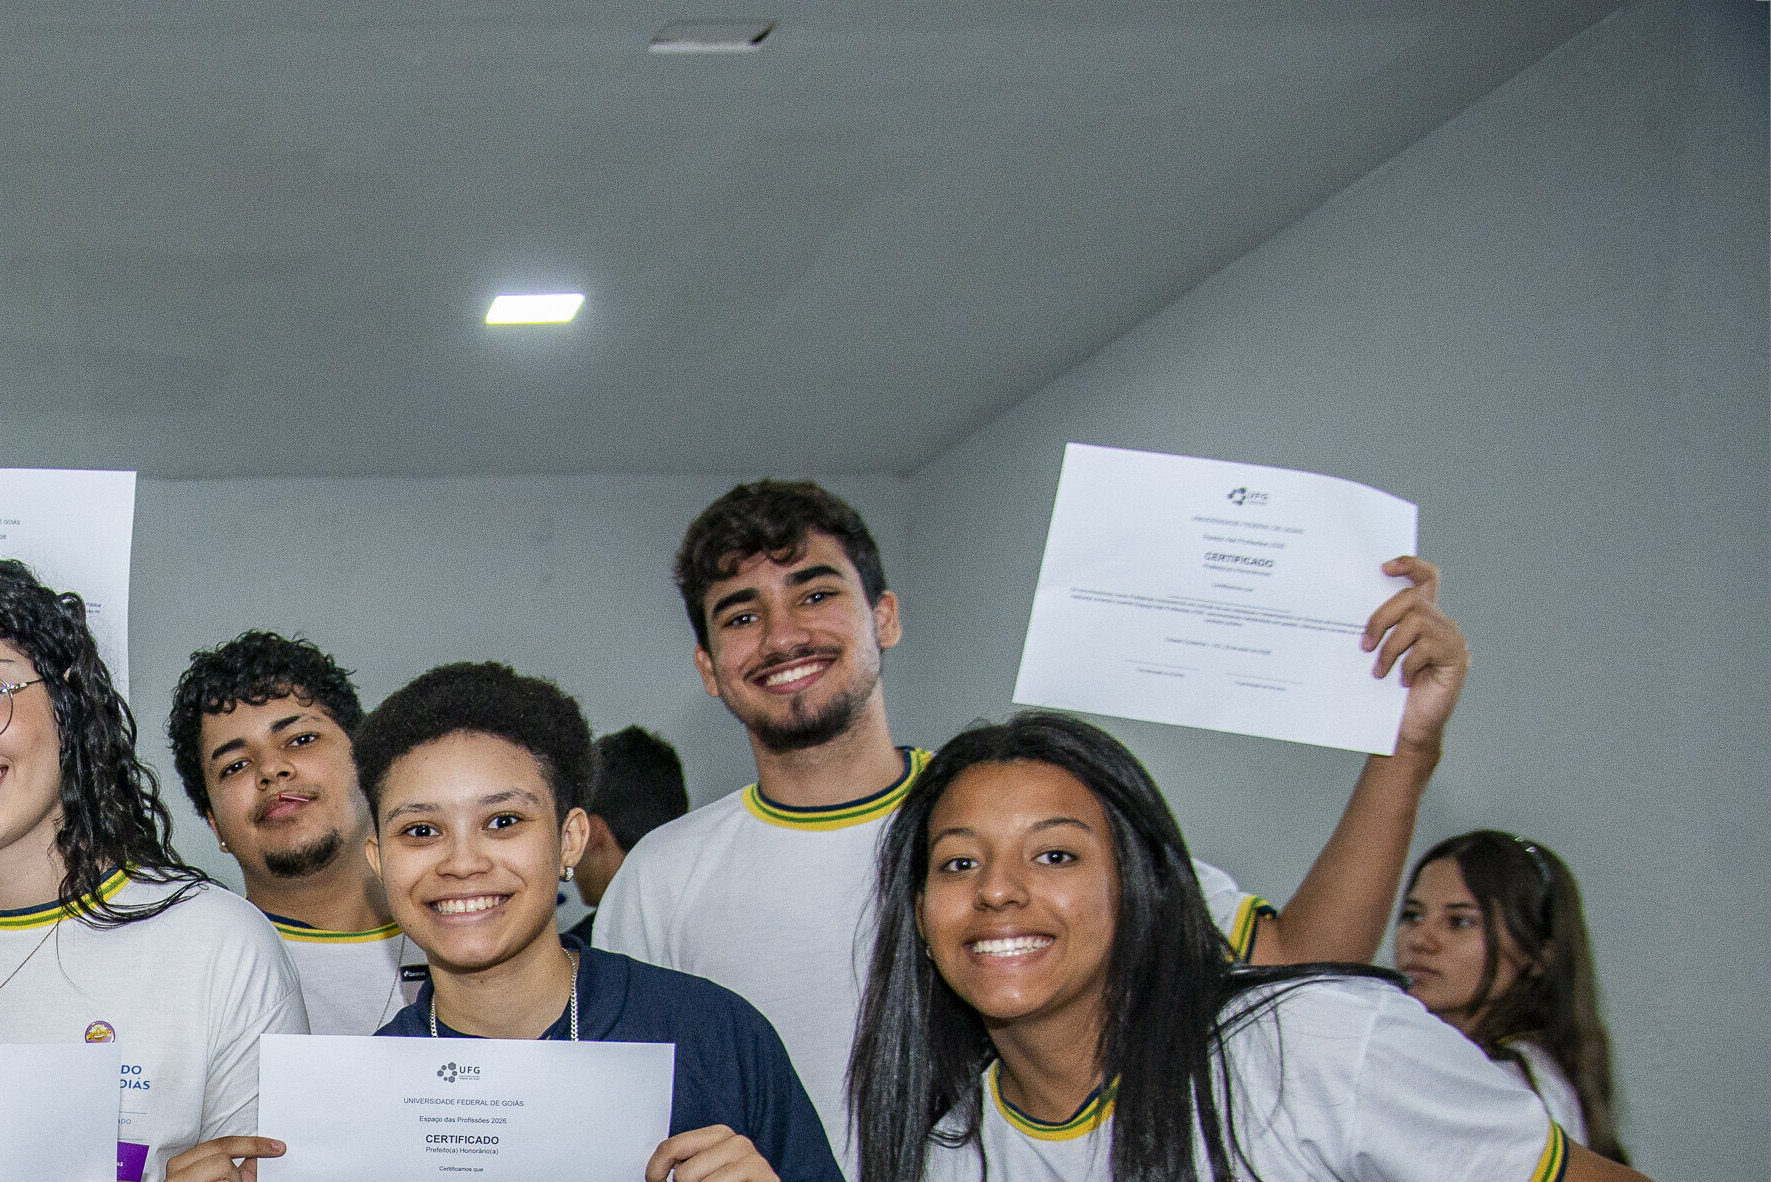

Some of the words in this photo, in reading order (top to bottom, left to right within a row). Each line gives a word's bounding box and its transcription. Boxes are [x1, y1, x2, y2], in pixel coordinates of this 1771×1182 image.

[459, 1066, 480, 1074] UFG
[502, 1099, 524, 1107] GOIÁS
[426, 1134, 499, 1145] CERTIFICADO
